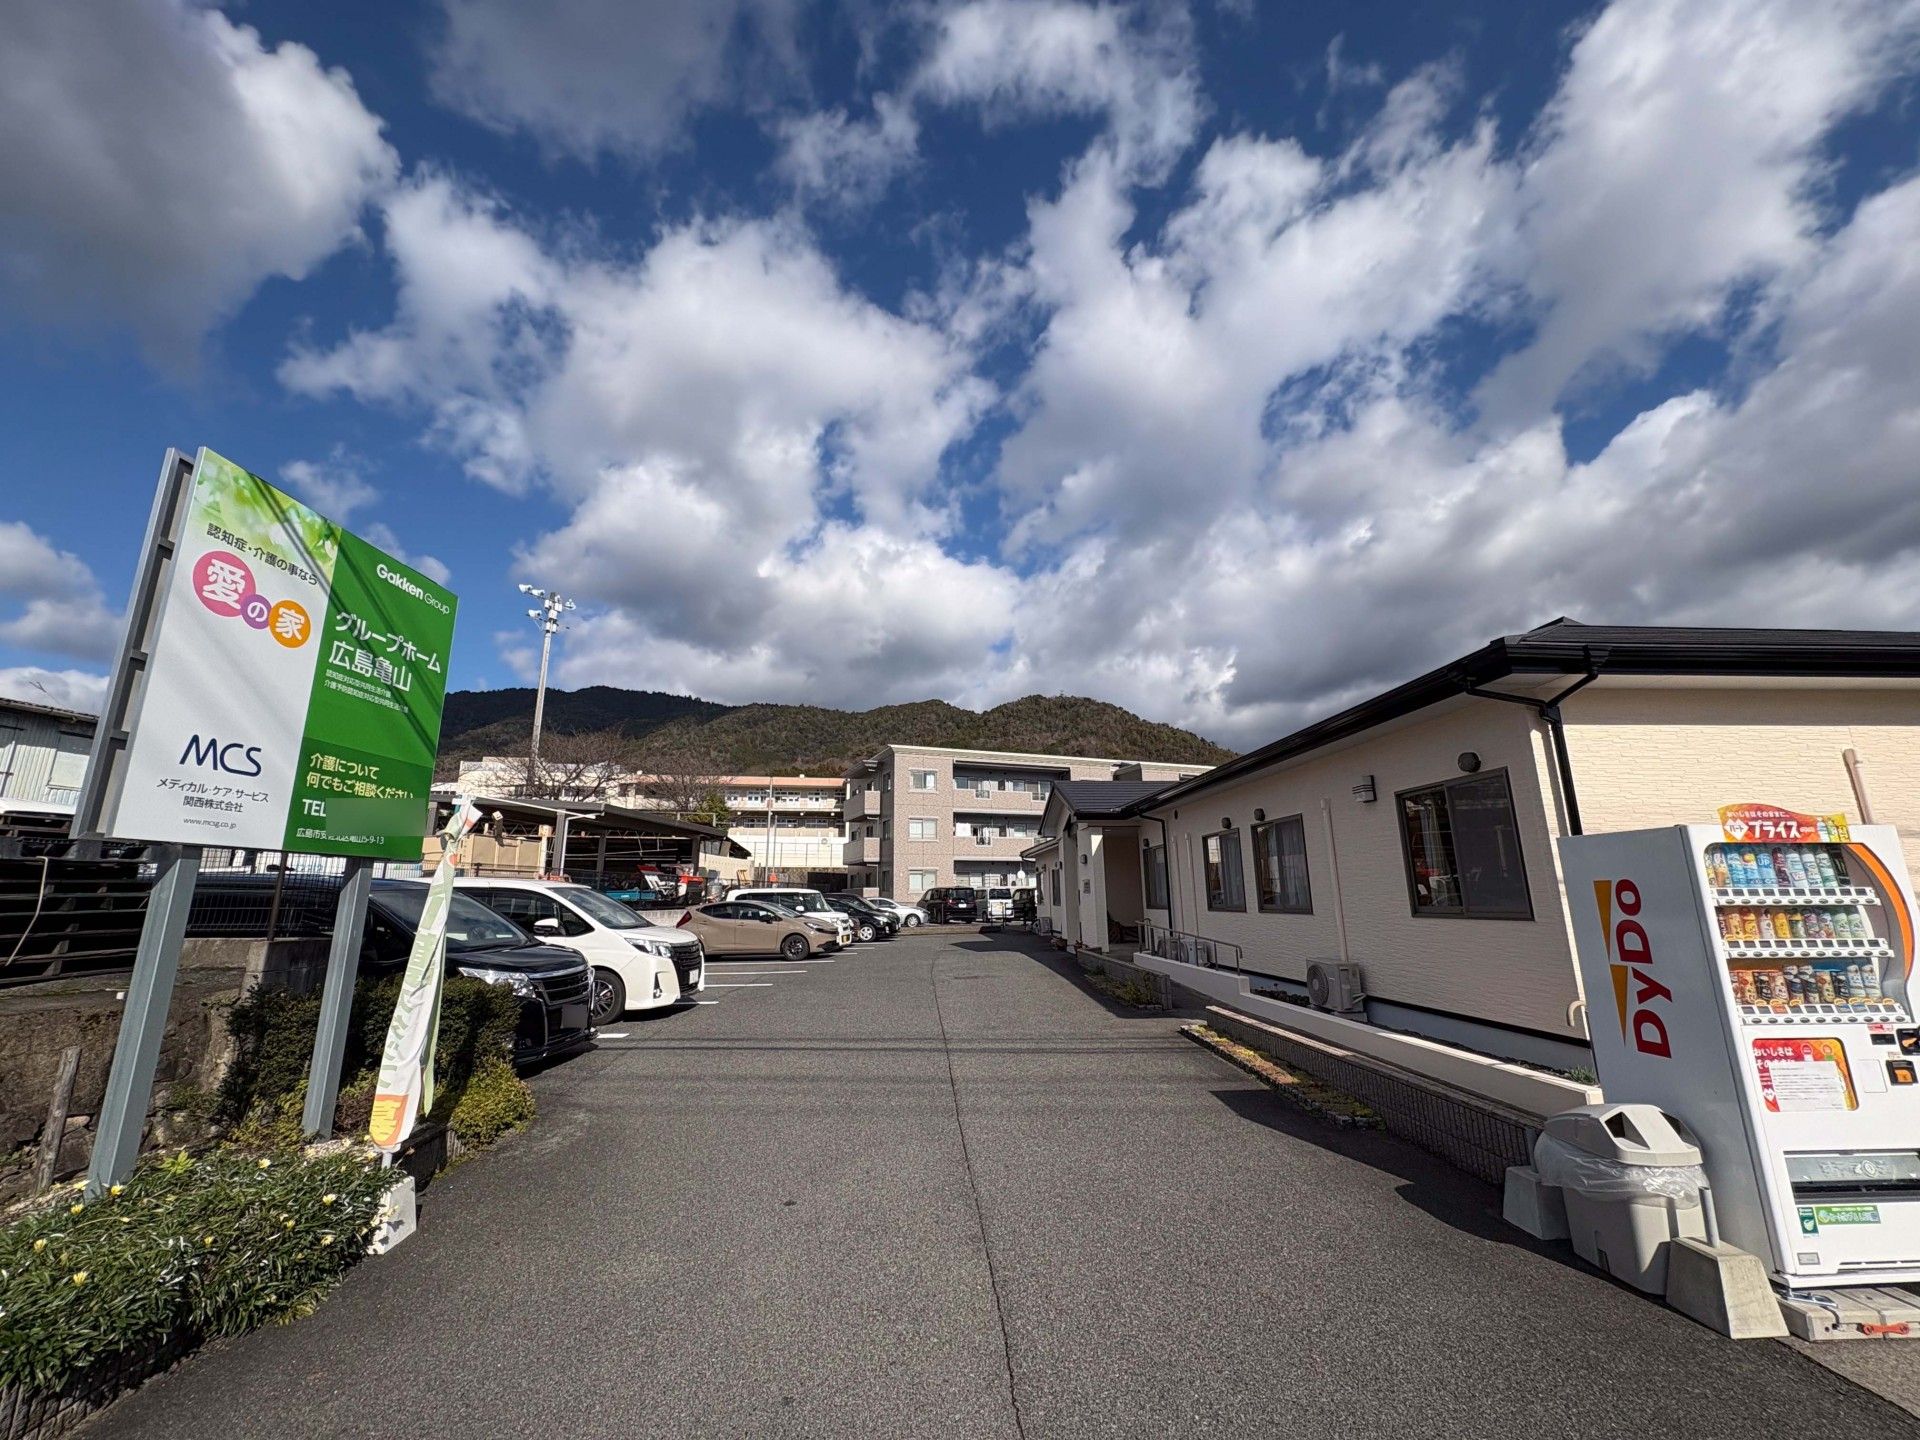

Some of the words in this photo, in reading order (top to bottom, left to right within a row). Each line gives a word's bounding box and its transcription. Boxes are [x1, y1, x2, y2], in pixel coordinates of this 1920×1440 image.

[206, 522, 319, 586] 認知症・介護の事なら
[202, 558, 305, 640] 愛の家
[376, 563, 424, 600] Gakken
[424, 593, 450, 615] Group
[335, 611, 441, 674] グループホーム
[328, 640, 412, 692] 広島亀山
[179, 734, 262, 777] MCS
[310, 752, 380, 780] 介護について
[306, 771, 414, 799] 何でもご相談ください
[182, 795, 244, 813] 関西株式会社
[302, 798, 327, 818] TEL
[183, 818, 237, 830] www.mcsg.co.jp
[1748, 819, 1801, 839] プライス
